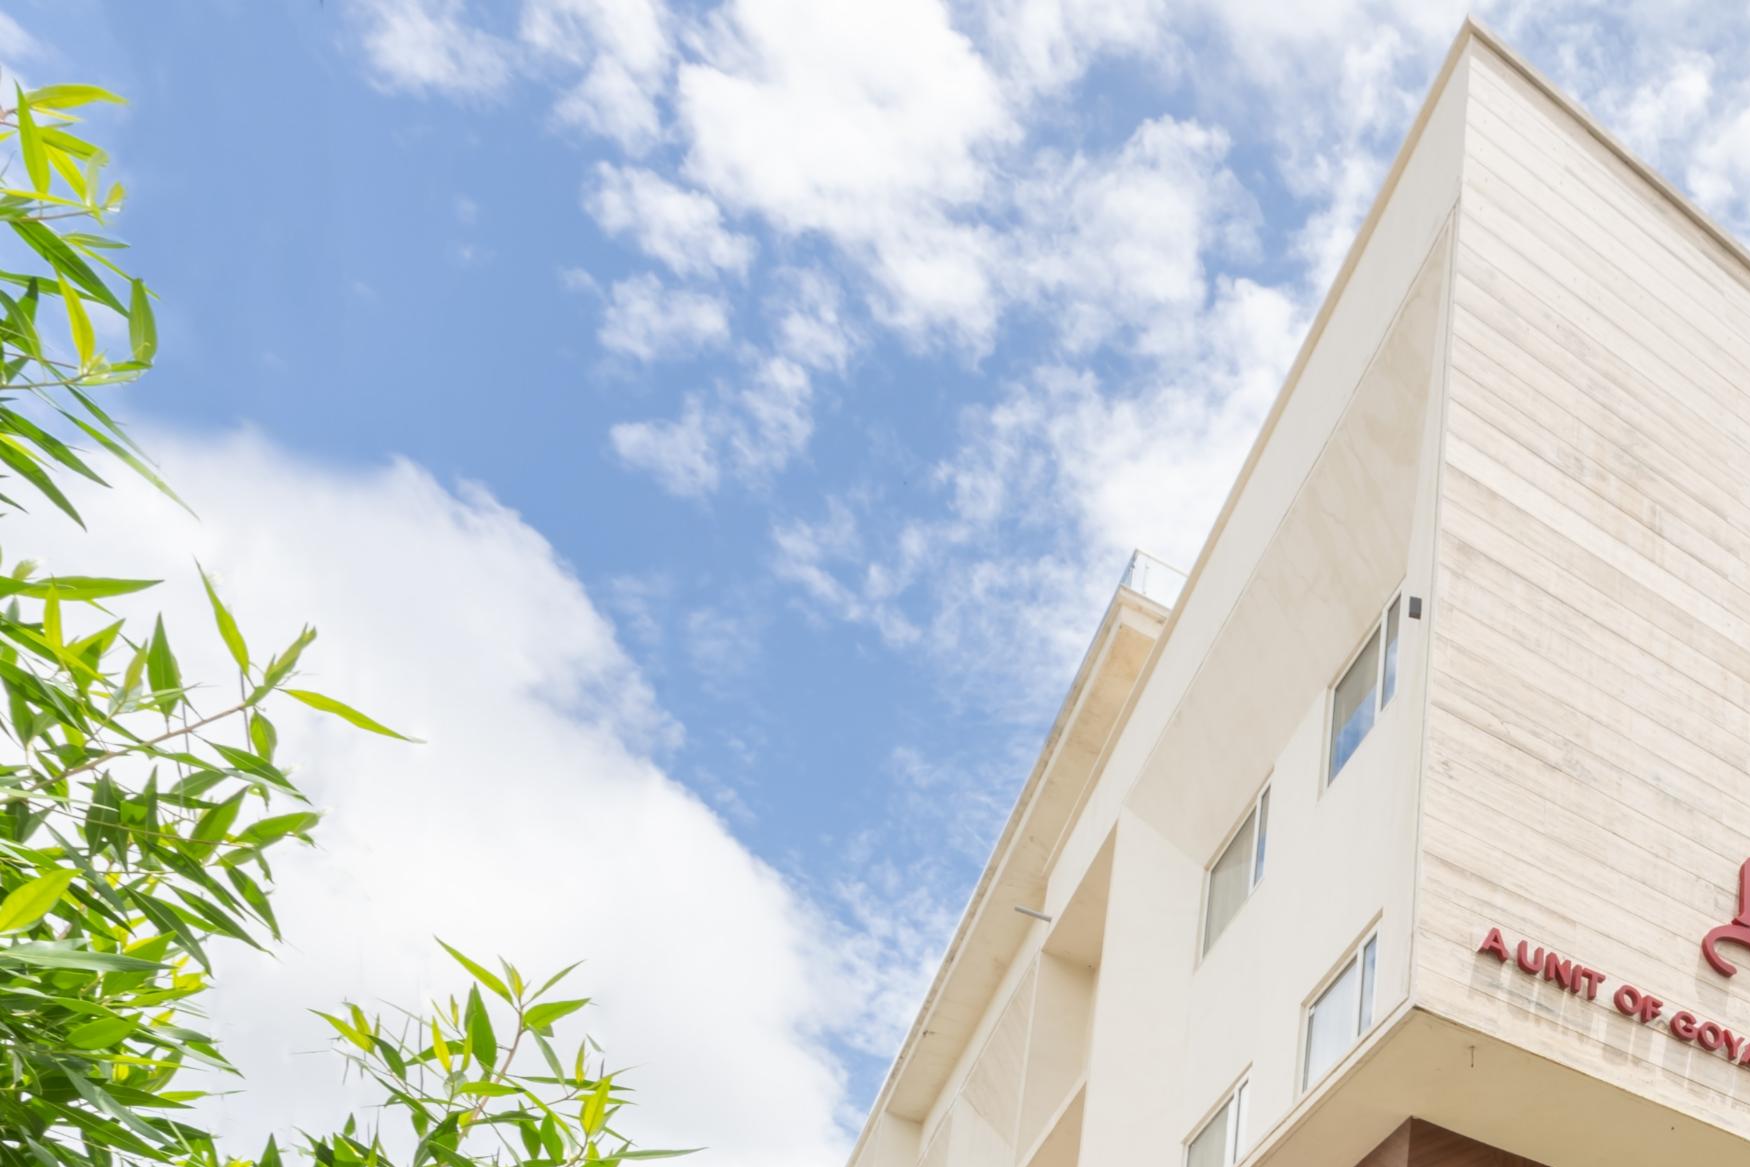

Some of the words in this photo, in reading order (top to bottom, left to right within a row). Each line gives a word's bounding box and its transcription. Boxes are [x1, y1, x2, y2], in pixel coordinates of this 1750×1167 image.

[1477, 926, 1510, 963] A
[1517, 940, 1606, 1001] UNIT
[1613, 984, 1664, 1024] OF
